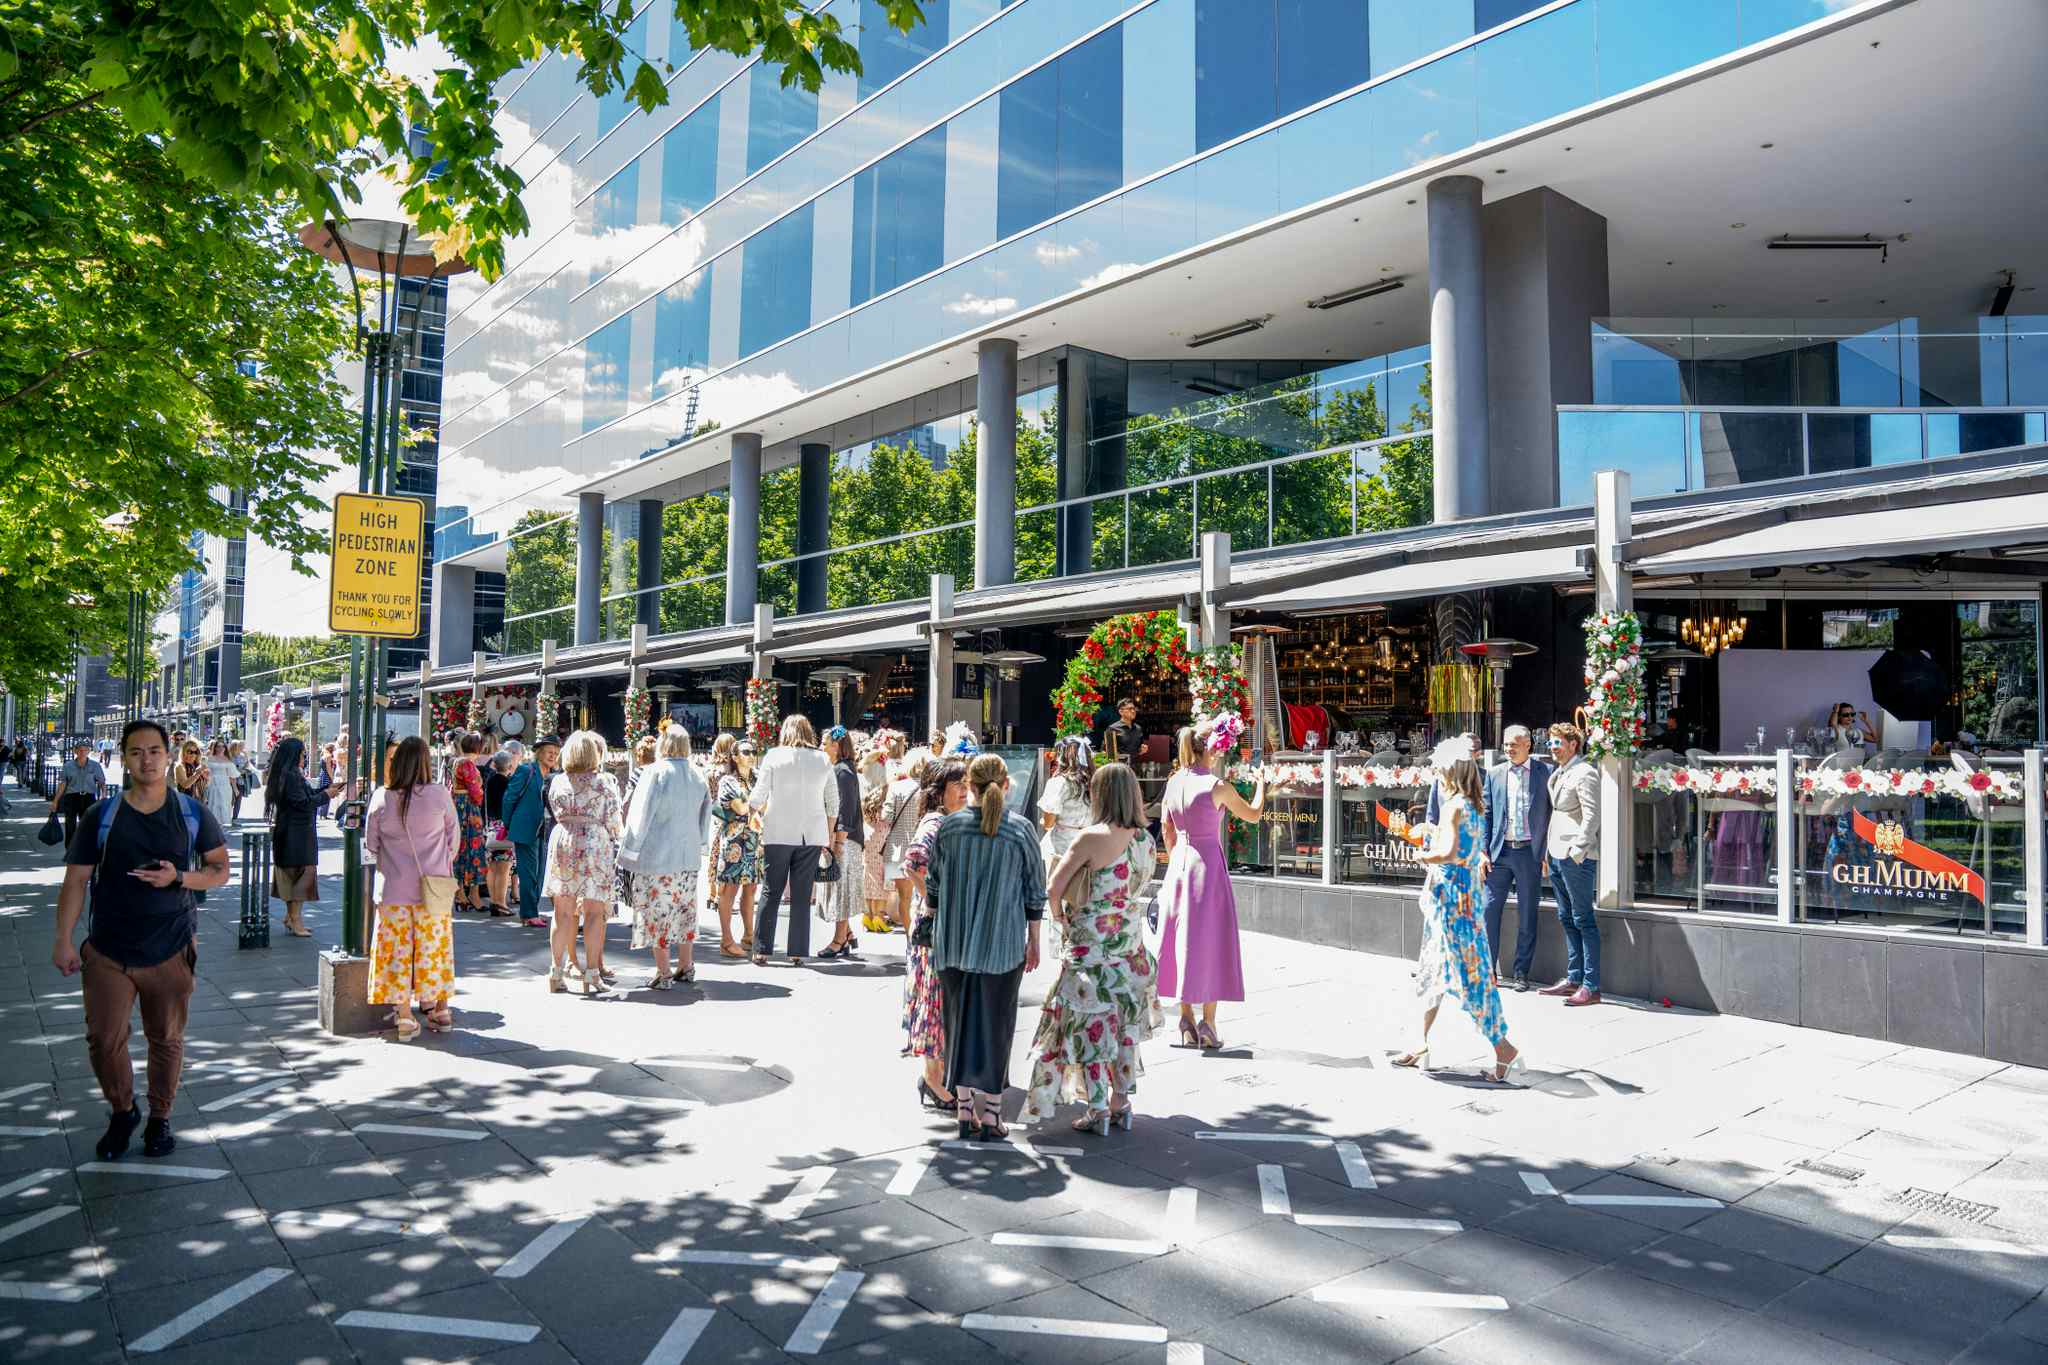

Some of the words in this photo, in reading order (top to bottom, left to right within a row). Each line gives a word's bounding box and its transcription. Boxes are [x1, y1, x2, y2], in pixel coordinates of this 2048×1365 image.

[360, 511, 397, 529] HIGH
[338, 532, 416, 555] PEDESTRIAN
[355, 558, 397, 576] ZONE
[337, 591, 368, 602] THANK
[371, 593, 390, 604] YOU
[393, 595, 412, 605] FOR
[334, 605, 374, 617] CYCLING
[377, 608, 413, 620] SLOWLY
[1260, 810, 1293, 822] HSCREEN
[1294, 812, 1318, 823] MENU
[1374, 861, 1428, 870] CHAMPAGN
[1852, 886, 1948, 900] CHAMPAGNE
